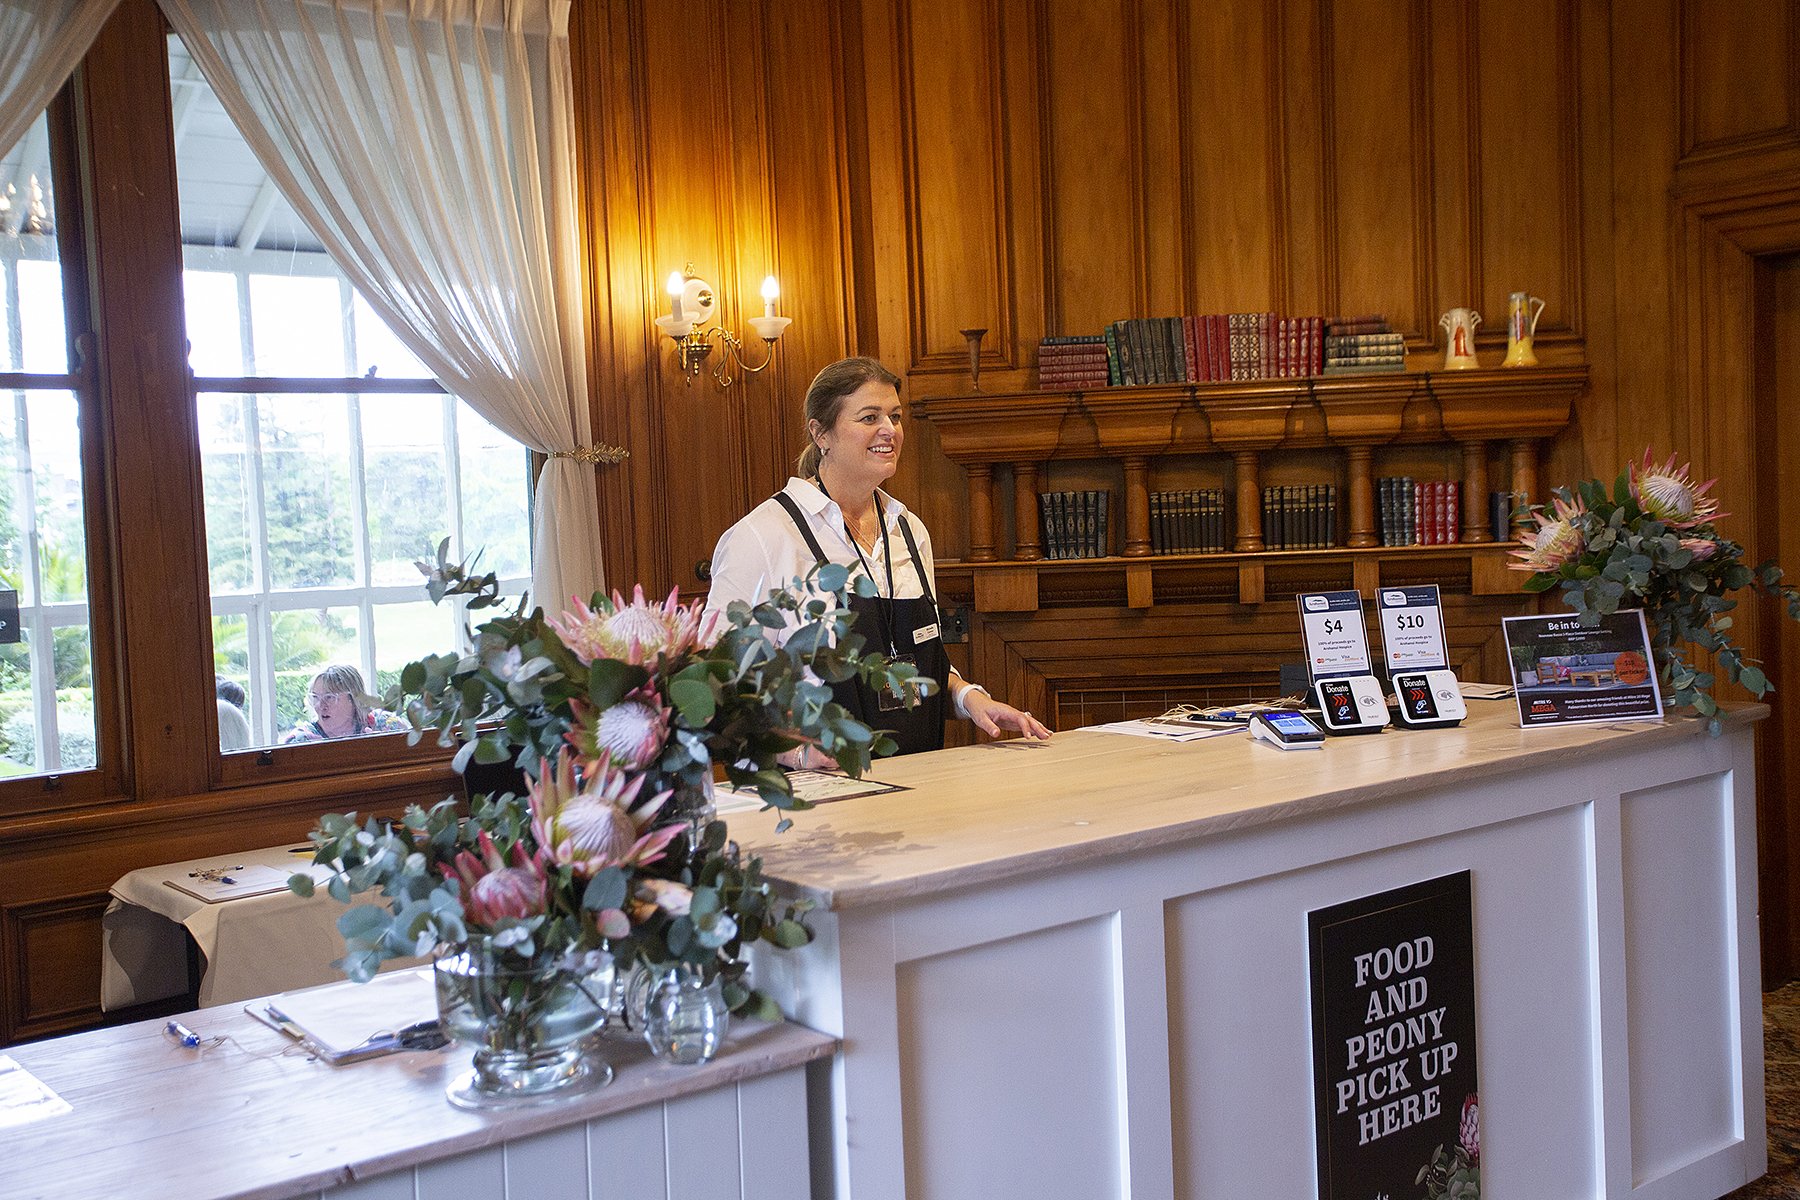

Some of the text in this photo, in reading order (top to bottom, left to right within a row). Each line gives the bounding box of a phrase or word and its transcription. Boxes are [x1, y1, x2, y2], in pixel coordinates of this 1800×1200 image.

[1324, 618, 1343, 635] $4
[1397, 614, 1424, 630] $10
[1548, 622, 1559, 630] Be
[1560, 621, 1569, 629] in
[1531, 704, 1556, 712] MEGA
[1354, 935, 1434, 988] FOOD
[1364, 976, 1428, 1024] AND
[1346, 1006, 1447, 1070] PEONY
[1336, 1041, 1458, 1114] PICK UP
[1358, 1089, 1441, 1146] HERE
